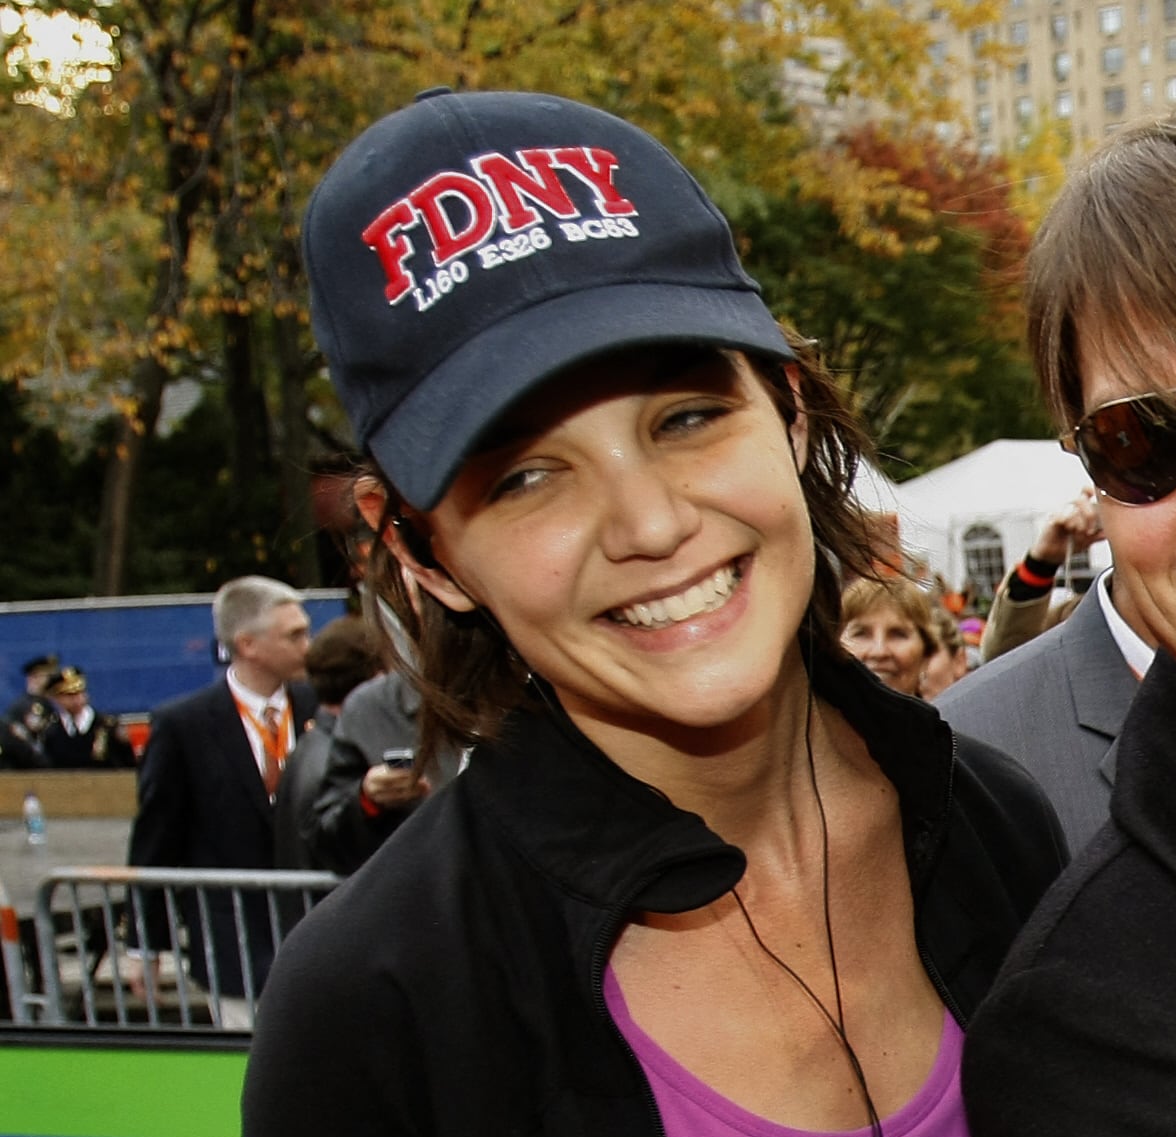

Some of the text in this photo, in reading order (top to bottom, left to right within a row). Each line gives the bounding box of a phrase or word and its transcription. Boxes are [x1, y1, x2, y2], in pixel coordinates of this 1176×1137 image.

[362, 146, 639, 305] FDNY
[412, 260, 469, 312] L160
[477, 227, 552, 270] E326
